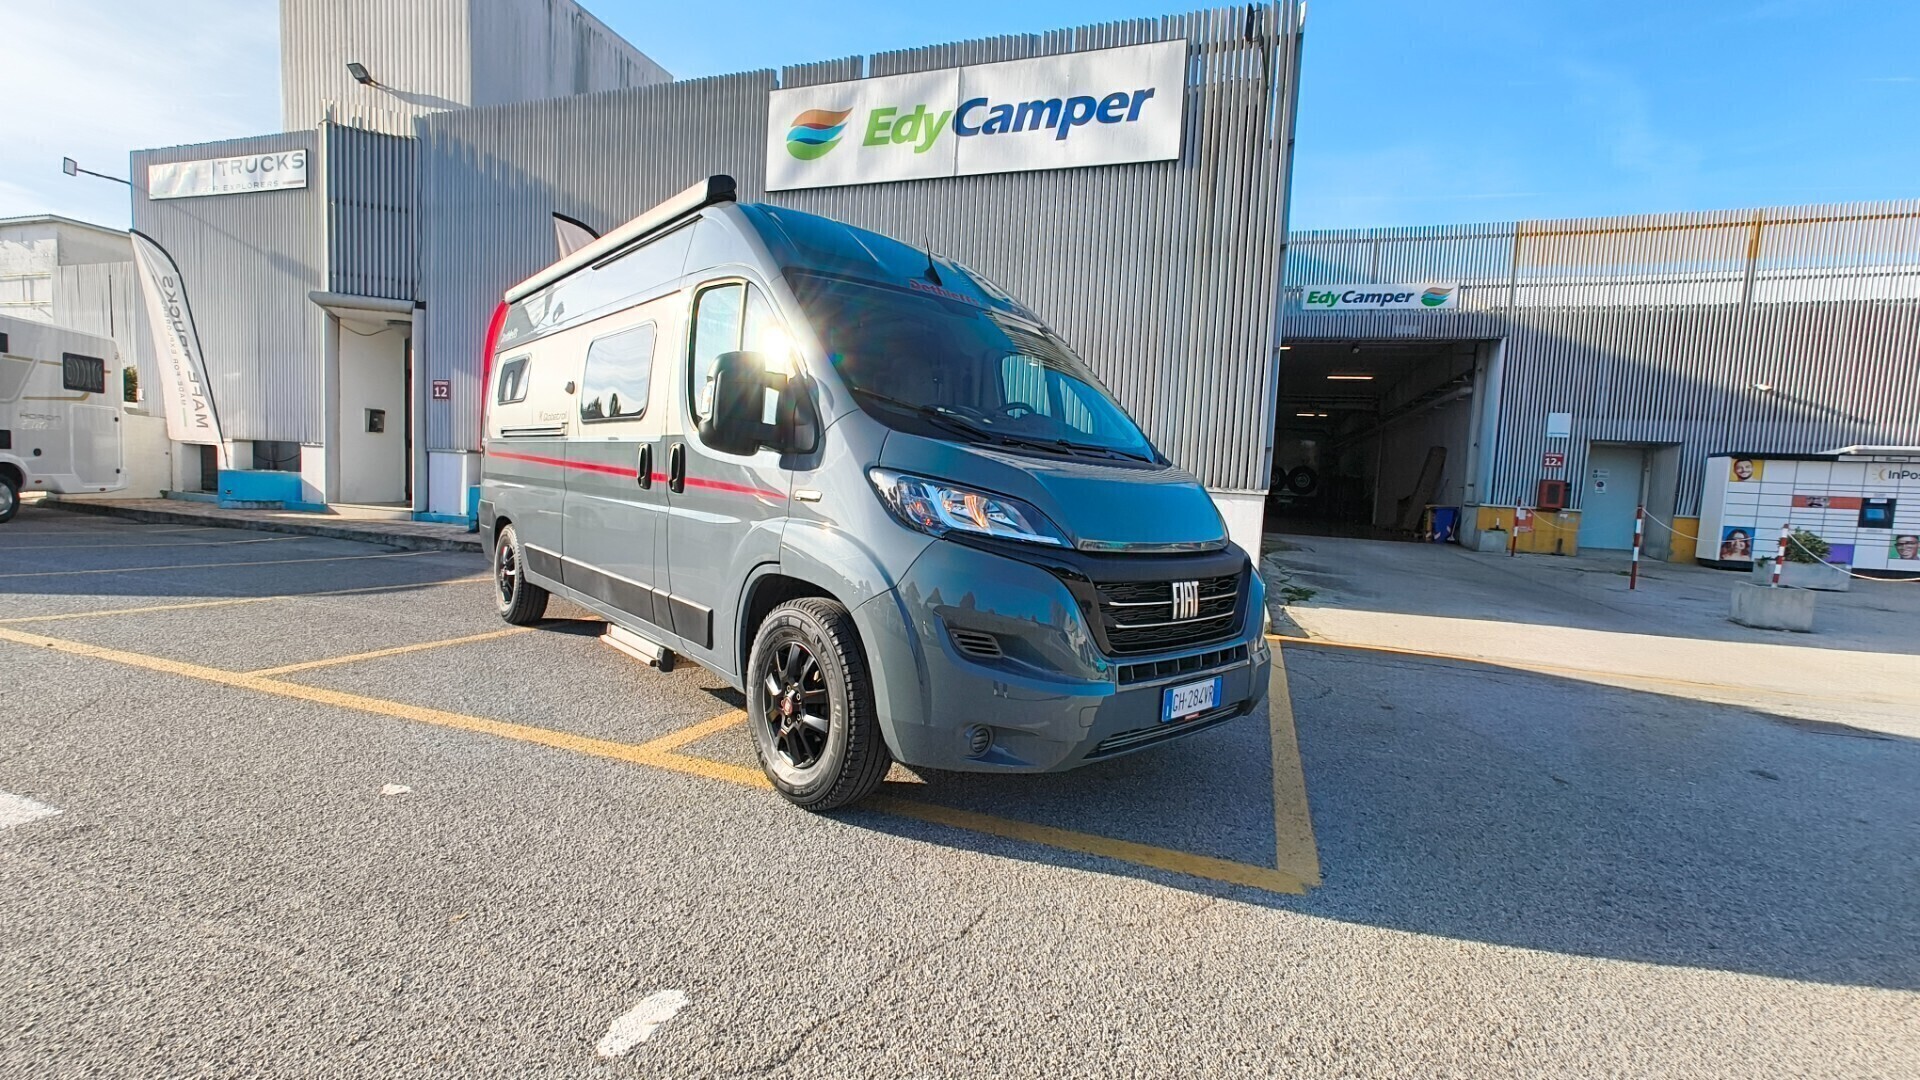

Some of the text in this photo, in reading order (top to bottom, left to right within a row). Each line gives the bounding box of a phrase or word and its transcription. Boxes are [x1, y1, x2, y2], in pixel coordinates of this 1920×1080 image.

[862, 87, 1156, 153] EdyCamper
[217, 153, 304, 176] TRUCKS
[223, 180, 279, 191] EXPLORERS
[1306, 290, 1415, 308] EdyCamper
[434, 386, 448, 397] 12
[1888, 470, 1920, 480] InPo
[1172, 581, 1199, 619] FIAT
